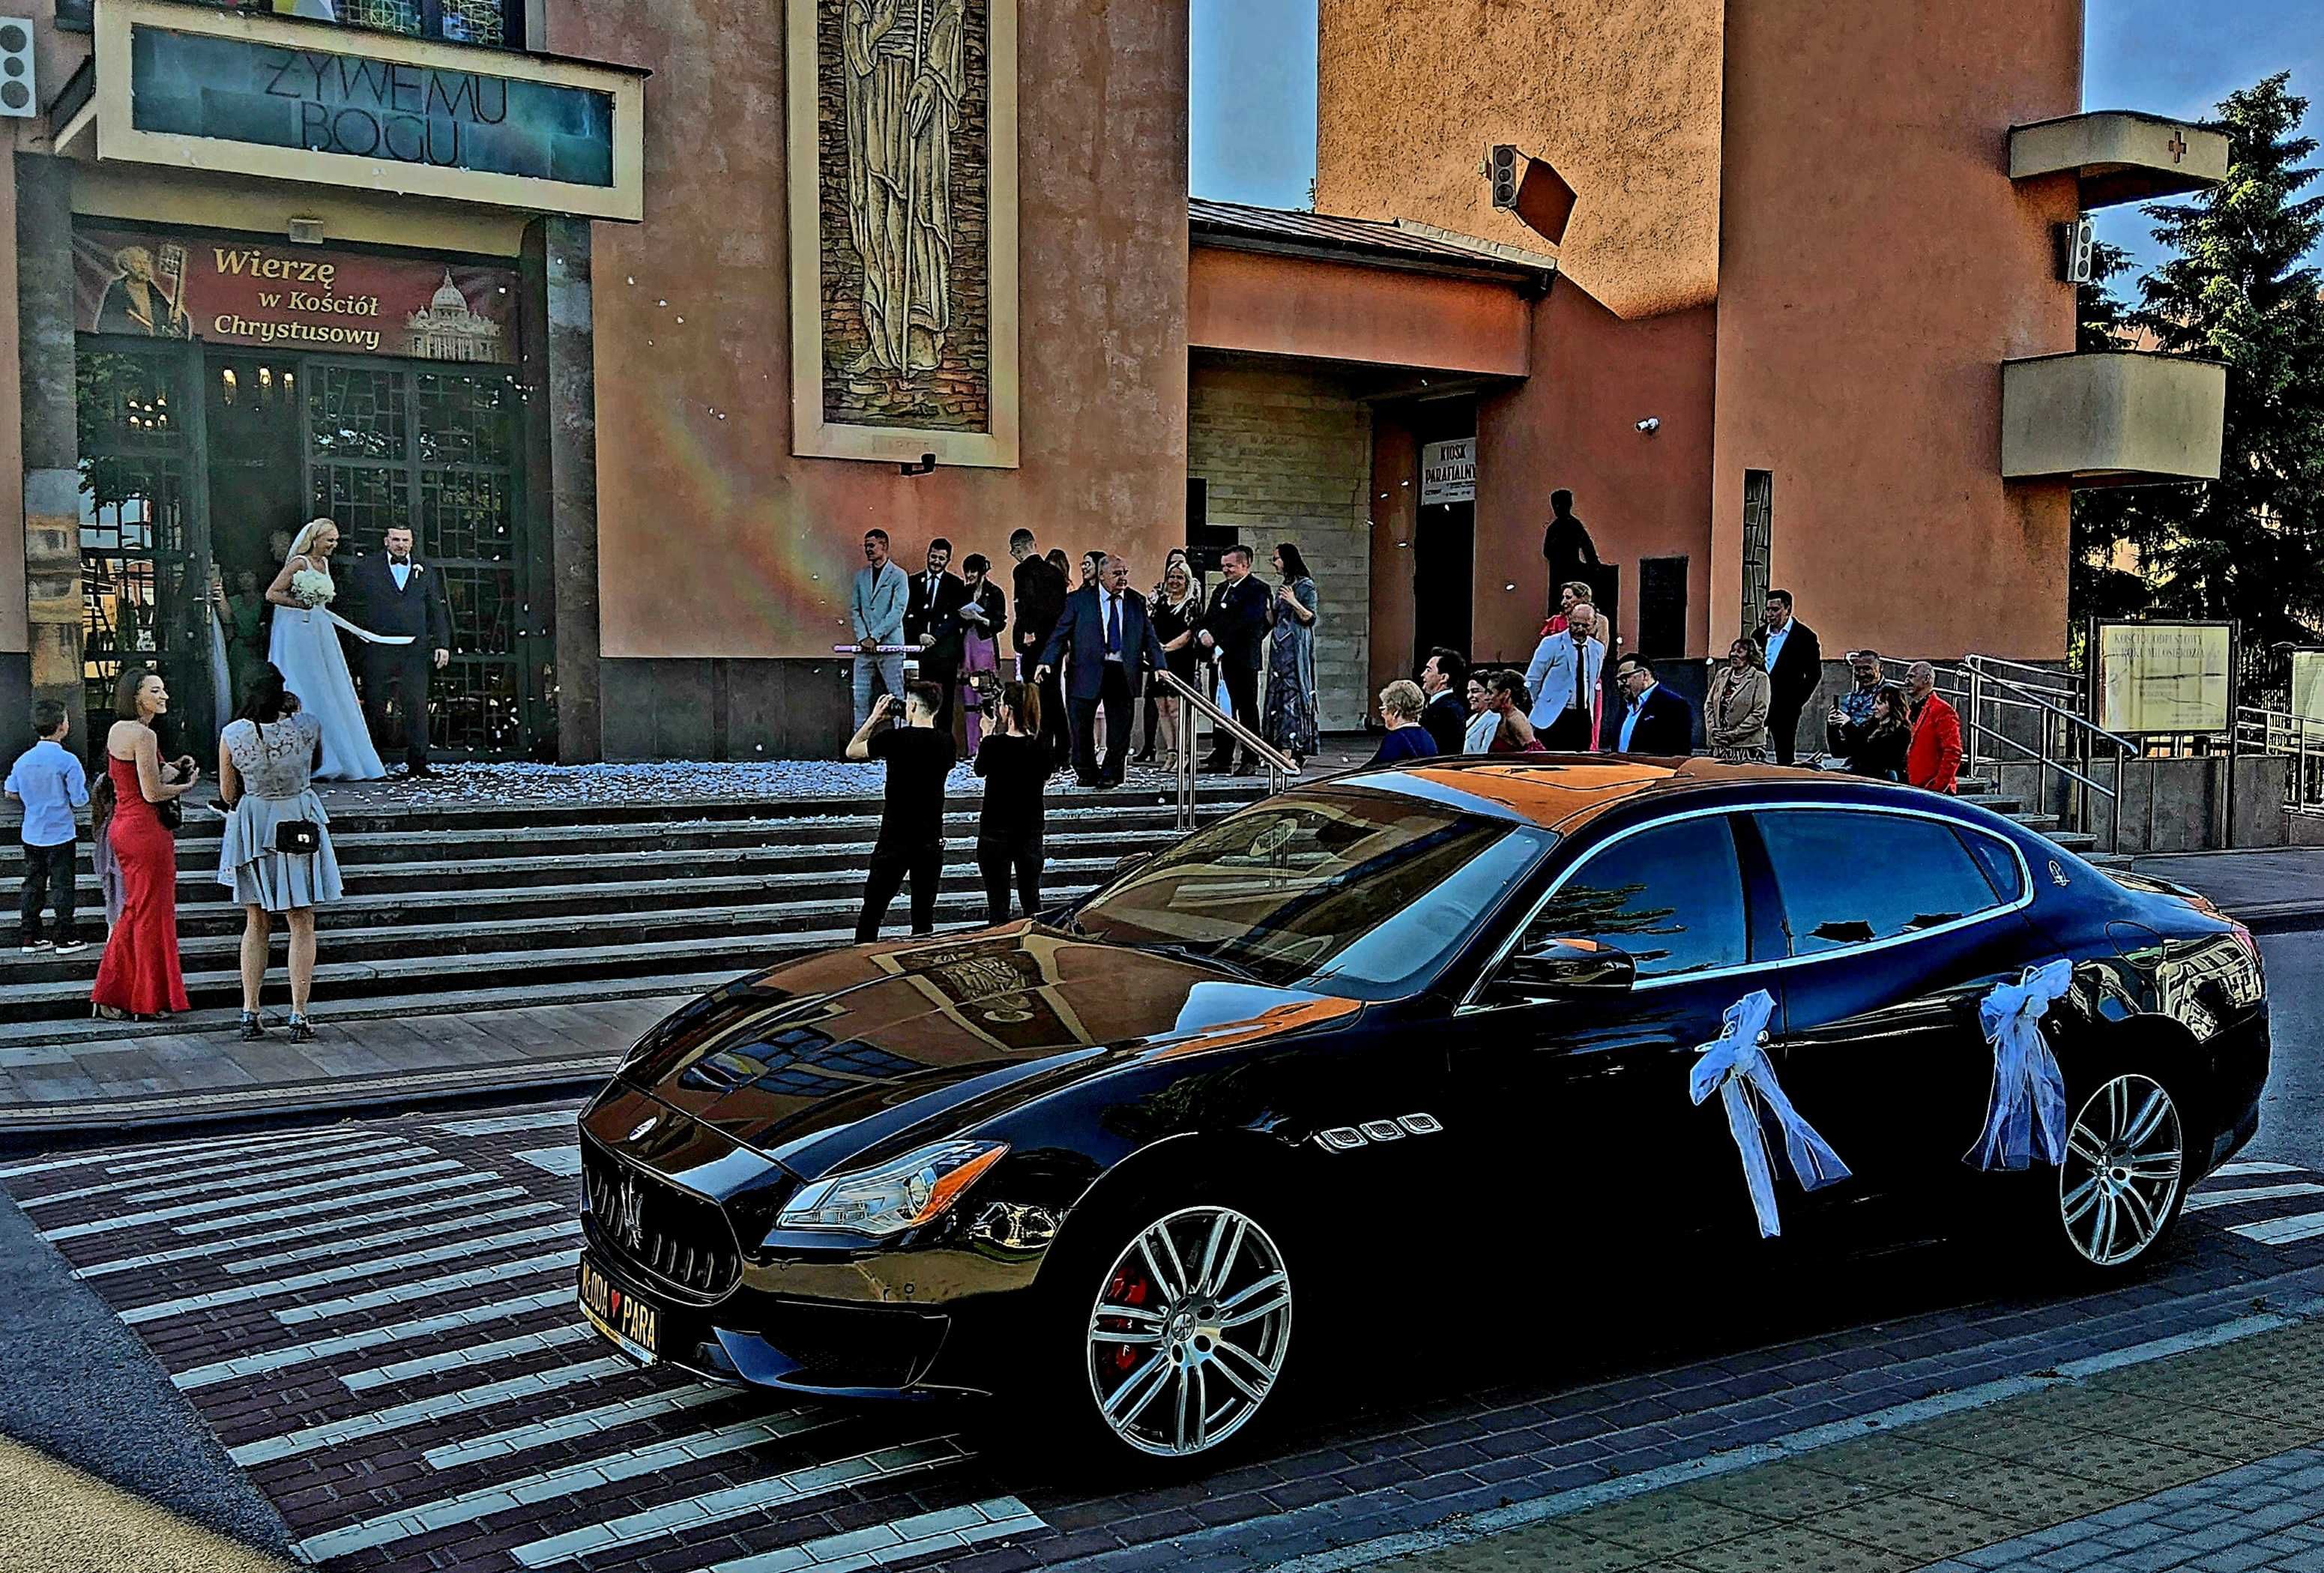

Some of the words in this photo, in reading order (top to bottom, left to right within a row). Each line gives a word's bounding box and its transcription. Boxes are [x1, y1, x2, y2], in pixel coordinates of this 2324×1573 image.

[301, 101, 459, 166] BOGU
[214, 248, 335, 289] Wierzę
[259, 292, 281, 308] w
[287, 291, 380, 316] Kościół
[214, 315, 381, 351] Chrystusowy
[1440, 444, 1467, 462] KIOSK
[622, 1295, 655, 1350] PARA
